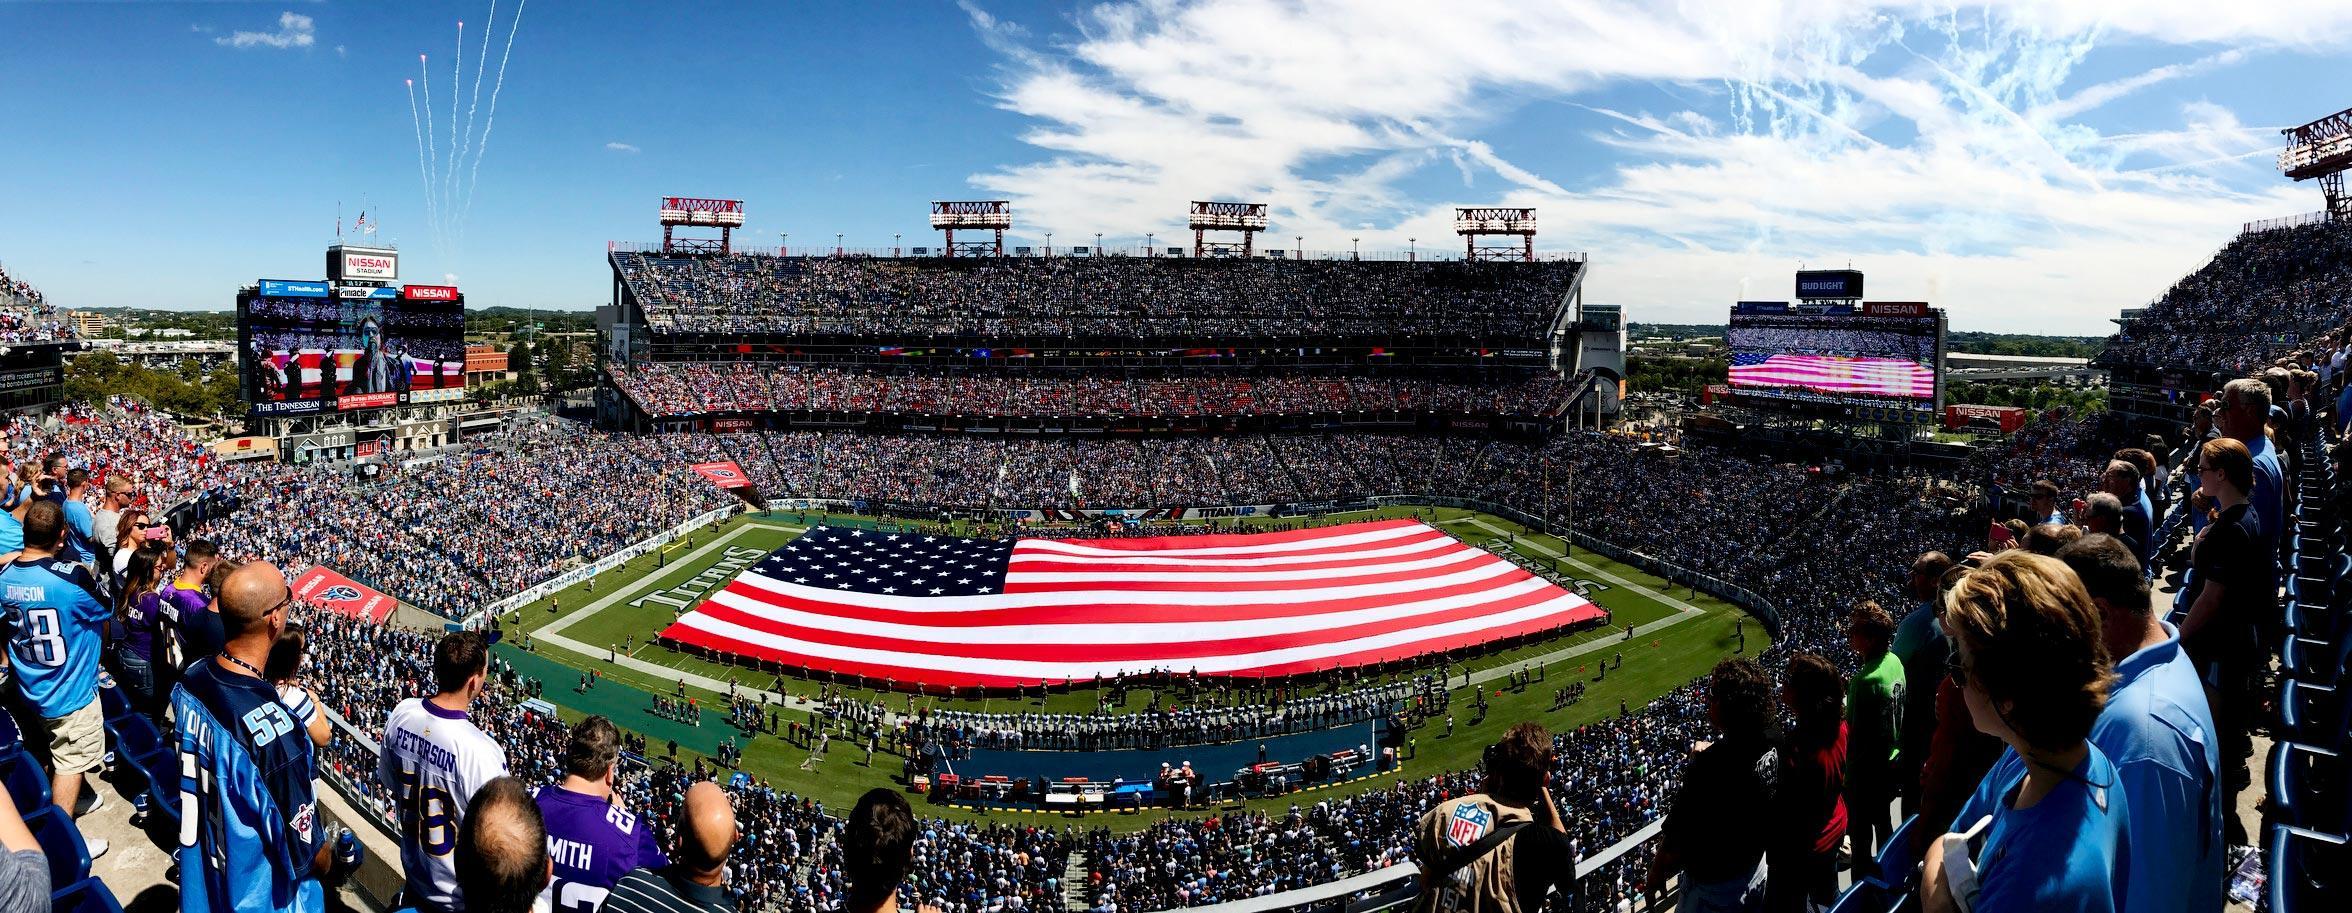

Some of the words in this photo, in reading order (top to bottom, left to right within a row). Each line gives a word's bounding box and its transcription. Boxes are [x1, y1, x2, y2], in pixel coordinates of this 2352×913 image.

[348, 257, 390, 269] NISSAN
[1801, 282, 1819, 290] BUD
[1819, 282, 1844, 290] LIGHT
[412, 288, 451, 298] NISSAN
[1871, 304, 1918, 314] NISSAN
[1707, 386, 1729, 394] NISSA
[256, 402, 274, 412] THE
[274, 400, 320, 412] TENNESSEAN
[1956, 407, 2001, 418] NISSAN
[1452, 421, 1489, 429] NISSAN
[626, 545, 769, 612] TITANS
[5, 585, 46, 602] JOHNSON
[242, 701, 295, 747] 53
[394, 727, 457, 773] PETERSON
[1449, 818, 1480, 845] NFL
[546, 834, 593, 871] MITH
